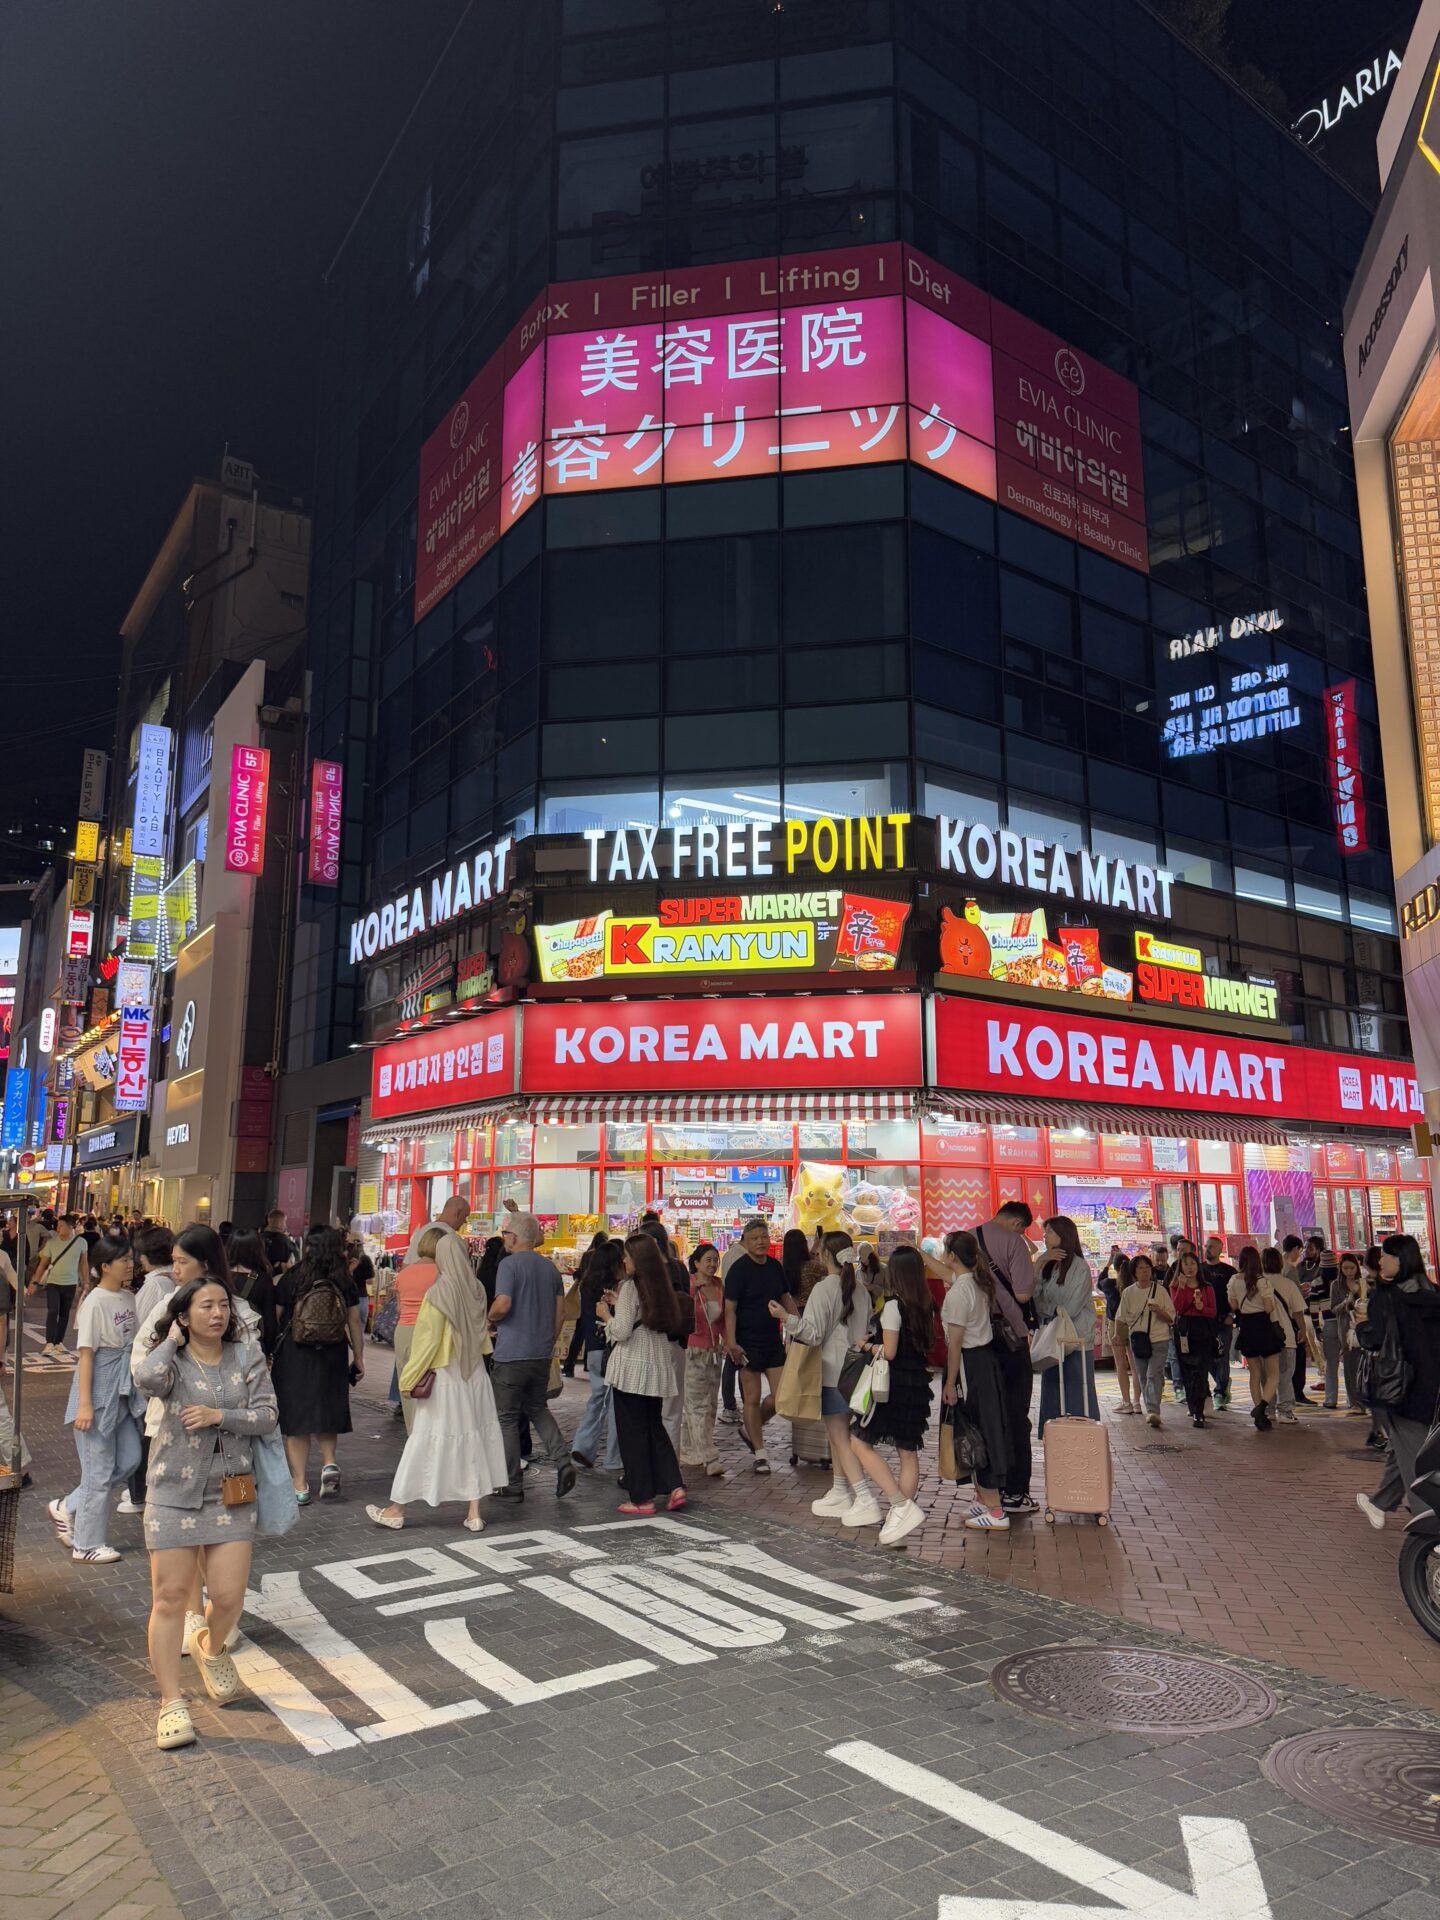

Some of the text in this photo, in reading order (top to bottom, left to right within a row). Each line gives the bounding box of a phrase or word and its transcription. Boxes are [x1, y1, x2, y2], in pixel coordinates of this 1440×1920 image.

[520, 257, 953, 352] Botox Filler Lifting Diet
[579, 306, 868, 397] 美容医院
[1018, 377, 1122, 454] EVIA CLINIC
[428, 422, 489, 511] EVIA CLINIC
[510, 403, 960, 516] 美容クリニック
[1015, 419, 1129, 508] 에비아의원
[1007, 485, 1073, 530] Dermatology
[1083, 522, 1117, 551] Beauty
[1118, 539, 1144, 563] Clinic
[1082, 501, 1110, 529] 피부과
[245, 751, 258, 767] 5F
[82, 753, 95, 811] PHILSTAY
[149, 748, 164, 848] BEAUTY LAB 2
[233, 773, 251, 848] EVIA CLINIC
[251, 781, 266, 863] Botox Filler Lifting
[584, 812, 911, 883] TAX FREE POINT
[938, 815, 1175, 919] KOREA MART
[78, 873, 89, 902] HOTEL
[350, 839, 512, 964] KOREA MART
[660, 890, 843, 926] SUPERMARKET
[611, 924, 652, 964] K
[653, 930, 809, 964] RAMYUN
[817, 931, 830, 941] 2F
[847, 910, 879, 952] 辛
[990, 933, 1038, 949] Chapagetti
[1138, 936, 1198, 967] K RAMYUN
[457, 951, 487, 980] SUPER
[1044, 957, 1067, 974] 너구리
[1067, 941, 1088, 981] 辛
[457, 969, 493, 1003] MARKET
[1137, 962, 1278, 1020] SUPERMARKET
[123, 1007, 152, 1021] MK
[119, 1021, 148, 1098] 부동산
[555, 1019, 885, 1065] KOREA MART
[986, 1019, 1286, 1103] KOREA MART
[394, 1041, 484, 1092] 세계과자할인점
[1341, 1075, 1360, 1089] KOREA
[116, 1099, 147, 1109] 777-7727
[1342, 1085, 1361, 1102] MART
[166, 1123, 190, 1146] HEYTEA
[684, 1198, 709, 1206] ORION
